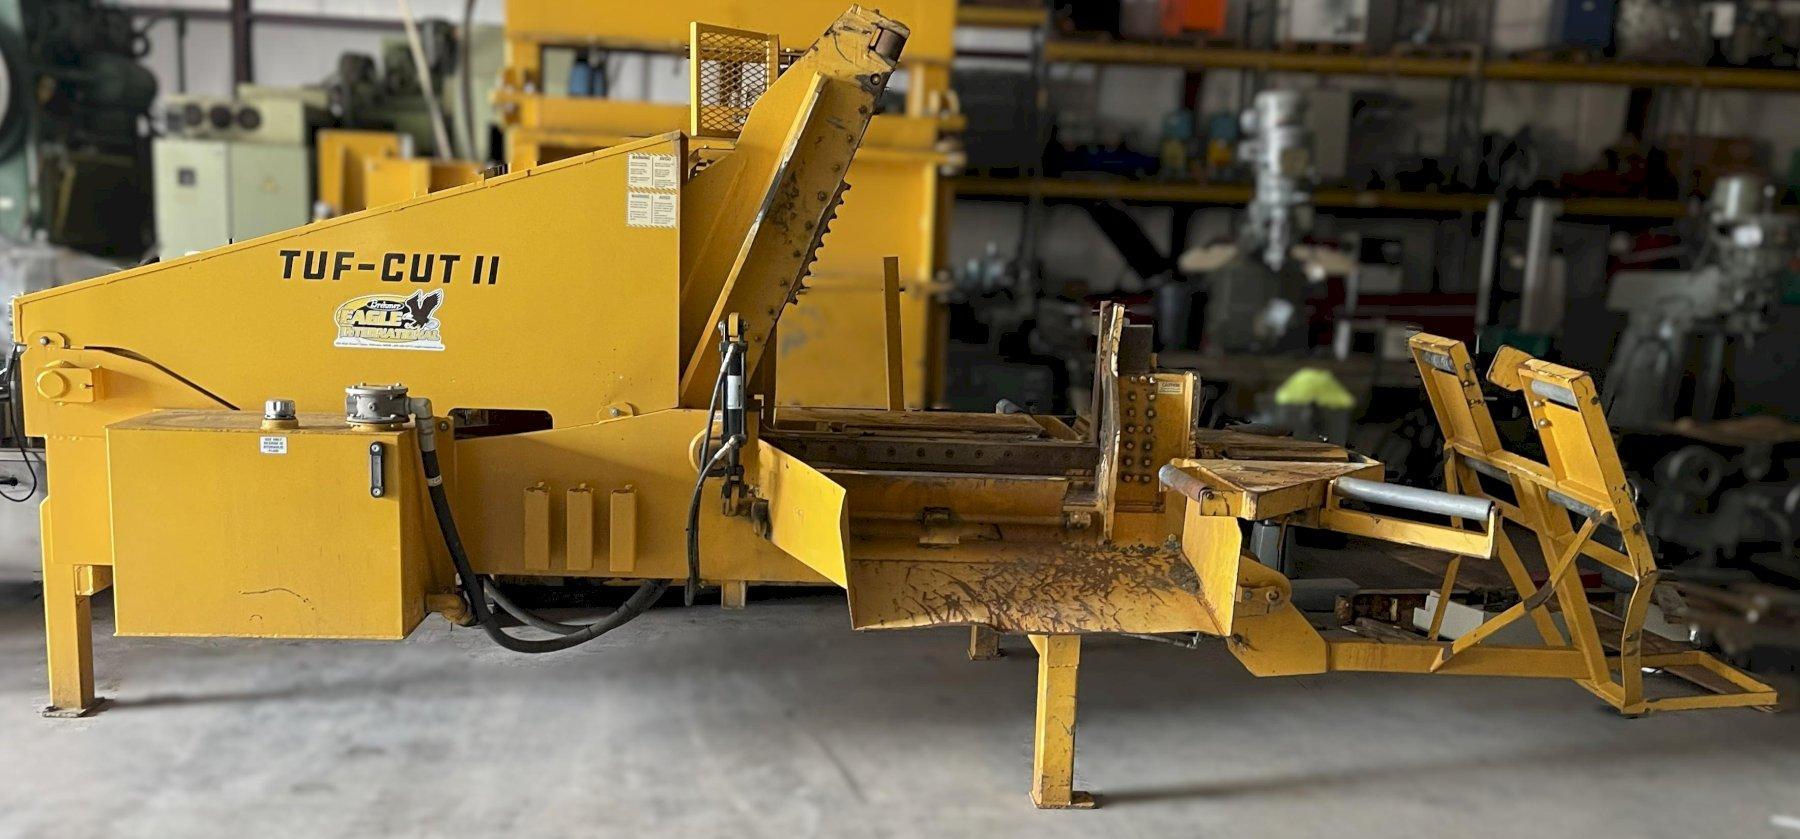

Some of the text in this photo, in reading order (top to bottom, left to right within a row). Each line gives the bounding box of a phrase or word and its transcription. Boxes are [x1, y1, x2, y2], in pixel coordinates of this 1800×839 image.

[279, 250, 500, 285] TUF-CUT II
[340, 308, 403, 327] EAGLE
[340, 326, 441, 341] INTERNATIONAL
